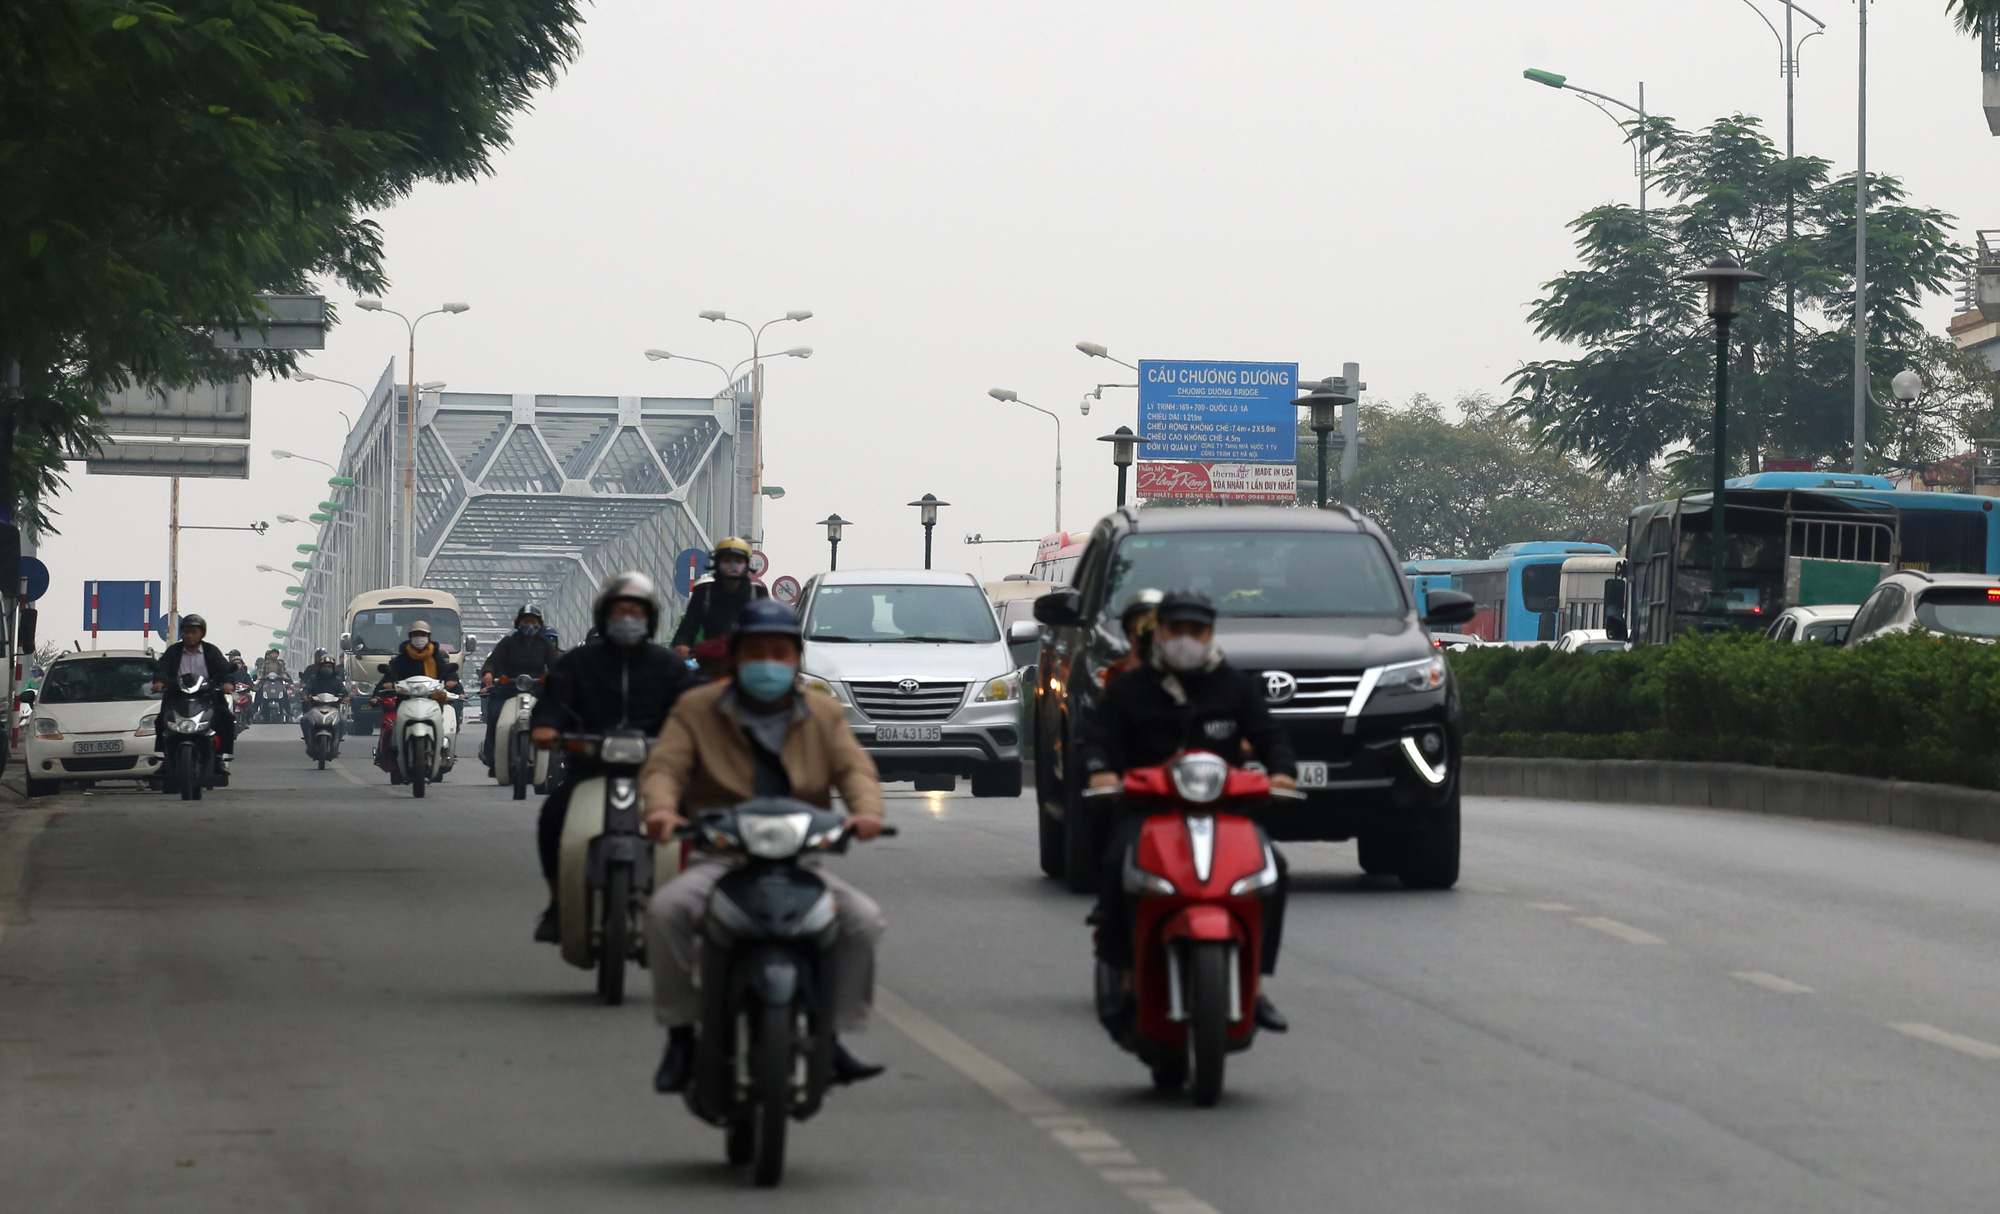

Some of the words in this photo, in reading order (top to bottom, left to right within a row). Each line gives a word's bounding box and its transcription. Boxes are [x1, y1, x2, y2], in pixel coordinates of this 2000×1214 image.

[1148, 364, 1176, 384] CẦU
[1179, 368, 1237, 384] CHƯƠNG
[1241, 369, 1289, 386] DƯƠNG
[1254, 468, 1272, 476] MADE
[1282, 468, 1294, 476] USA
[1265, 481, 1276, 490] DUY
[77, 742, 120, 752] 30Y-8305
